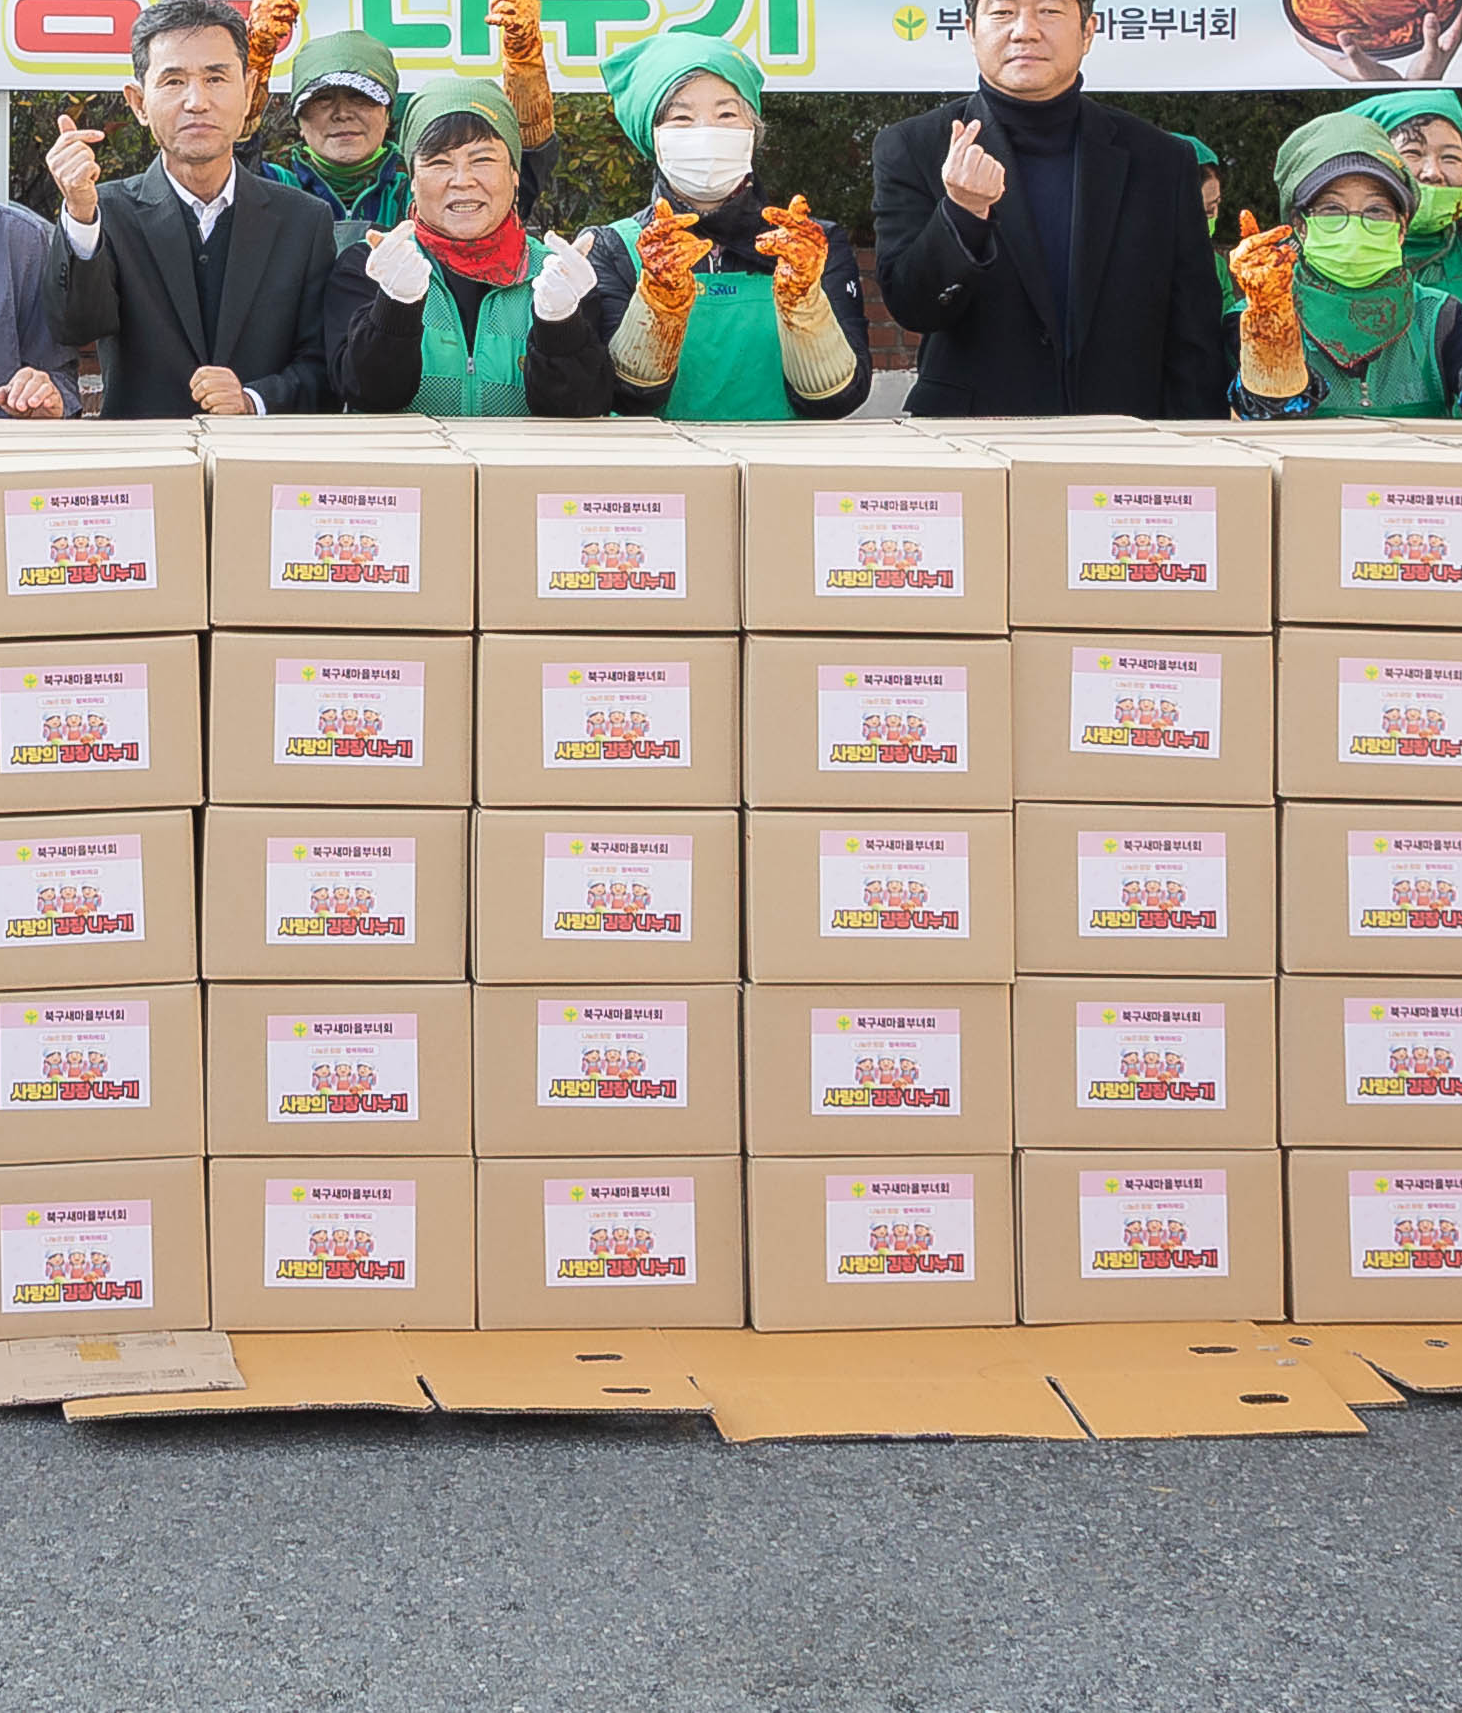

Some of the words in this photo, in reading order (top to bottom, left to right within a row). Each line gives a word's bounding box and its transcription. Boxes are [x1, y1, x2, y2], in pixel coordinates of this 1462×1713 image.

[583, 502, 661, 512] 북구새마을부녀회
[860, 500, 938, 510] 북구새마을부녀회
[1113, 494, 1192, 505] 북구새마을부녀회
[548, 570, 595, 589] 사랑의
[596, 571, 628, 590] 김장
[628, 571, 675, 590] 나누기
[826, 568, 873, 588] 사랑의
[873, 569, 906, 588] 김장
[906, 569, 953, 588] 나누기
[1079, 562, 1126, 581] 사랑의
[1127, 562, 1159, 581] 김장
[1159, 563, 1206, 582] 나누기
[44, 672, 123, 685] 북구새마을부녀회
[321, 668, 400, 680] 북구새마을부녀회
[1384, 667, 1462, 680] 북구새마을부녀회
[10, 744, 58, 764] 사랑의
[58, 743, 91, 763] 김장
[91, 741, 138, 762] 나누기
[285, 736, 333, 756] 사랑의
[332, 737, 365, 757] 김장
[365, 738, 412, 758] 나누기
[1349, 735, 1396, 755] 사랑의
[1396, 736, 1429, 756] 김장
[865, 839, 944, 850] 북구새마을부녀회
[831, 909, 878, 928] 사랑의
[879, 909, 911, 929] 김장
[911, 910, 958, 929] 나누기
[1360, 908, 1407, 928] 사랑의
[1407, 909, 1440, 928] 김장
[313, 1023, 393, 1033] 북구새마을부녀회
[279, 1093, 327, 1113] 사랑의
[327, 1093, 360, 1113] 김장
[360, 1093, 407, 1112] 나누기
[47, 1209, 127, 1222] 북구새마을부녀회
[12, 1282, 61, 1304] 사랑의
[61, 1281, 94, 1302] 김장
[94, 1279, 142, 1301] 나누기
